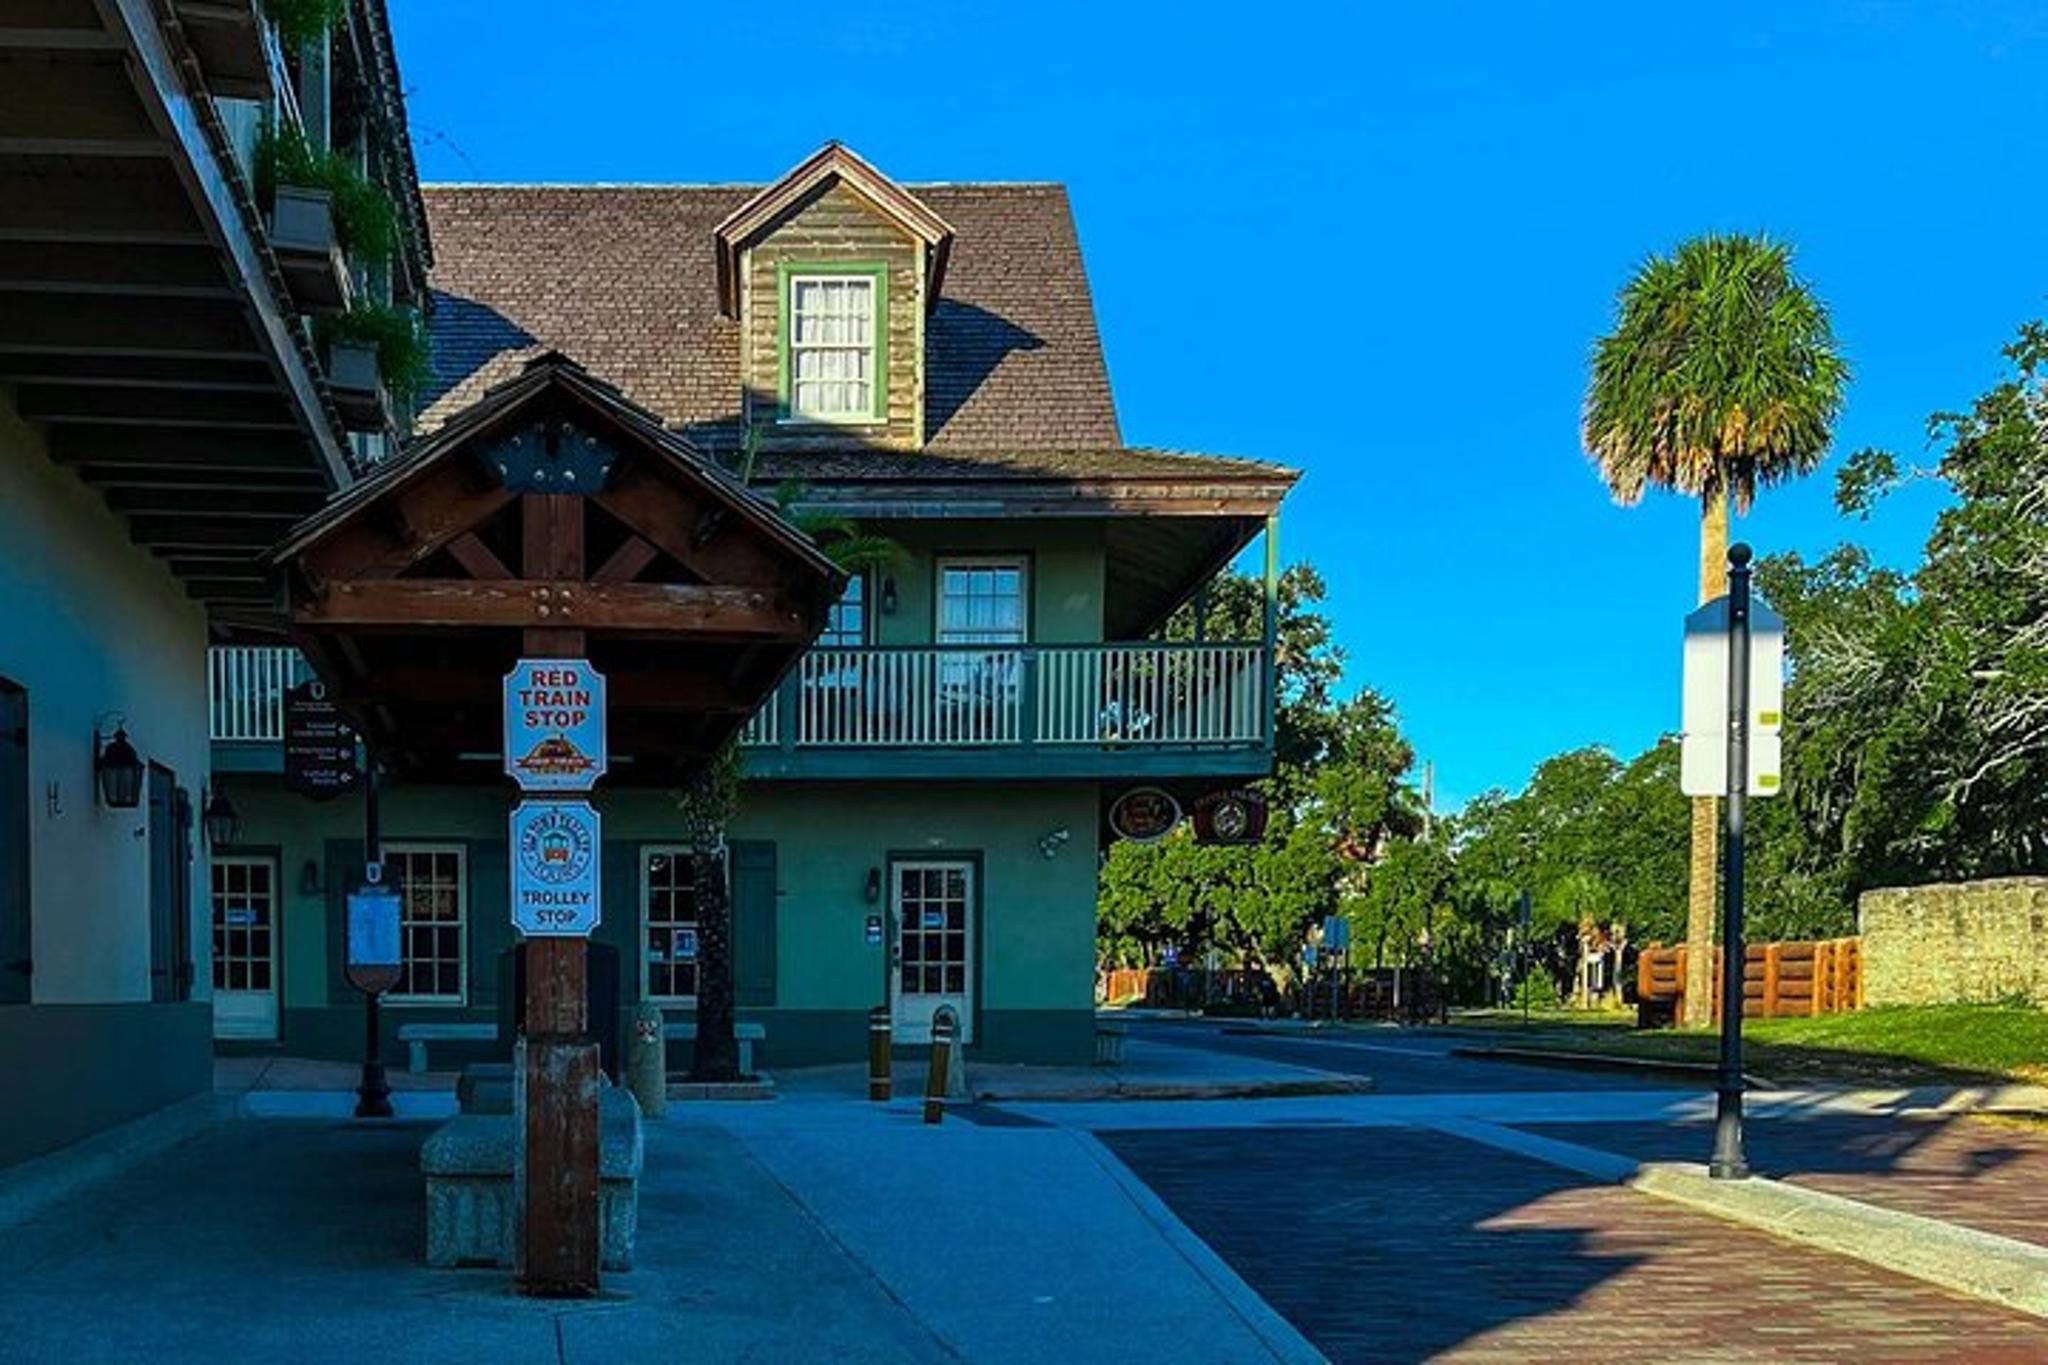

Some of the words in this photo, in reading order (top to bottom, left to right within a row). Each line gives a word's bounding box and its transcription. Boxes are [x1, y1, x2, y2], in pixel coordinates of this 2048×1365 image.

[532, 671, 578, 687] RED
[517, 690, 591, 706] TRAIN
[525, 710, 586, 726] STOP
[523, 891, 590, 905] TROLLEY
[536, 909, 578, 925] STOP
